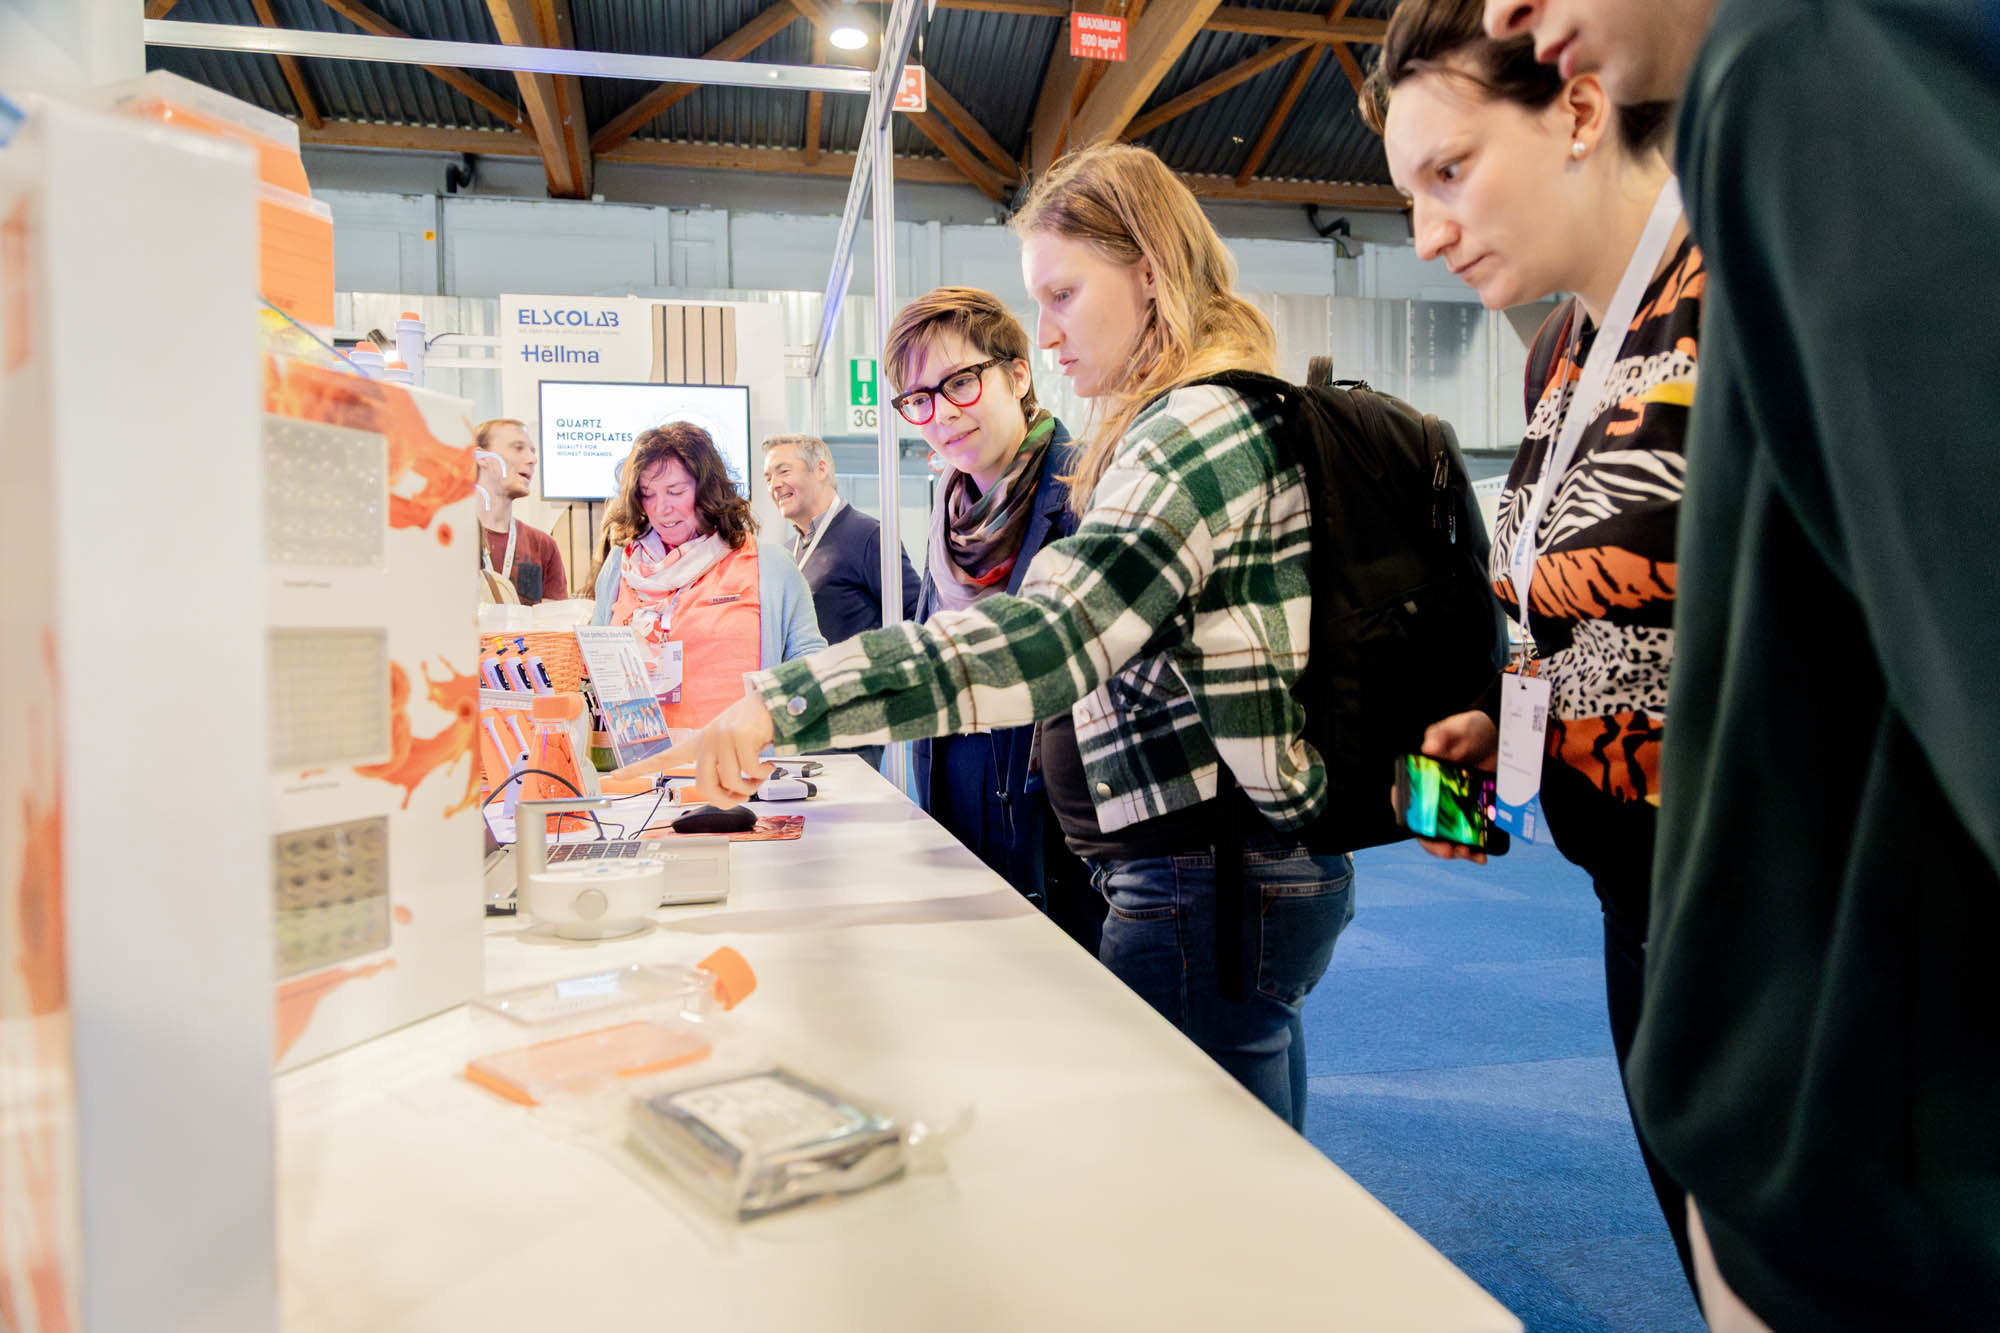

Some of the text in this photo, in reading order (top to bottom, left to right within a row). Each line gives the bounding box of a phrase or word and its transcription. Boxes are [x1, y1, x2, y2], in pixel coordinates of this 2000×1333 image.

[1078, 16, 1121, 32] MAXIMUM
[1080, 33, 1097, 47] 500
[518, 308, 620, 327] ELSCOLAB
[556, 418, 602, 428] QUARTZ
[853, 409, 878, 428] 3G
[556, 432, 633, 442] MICROPLATES
